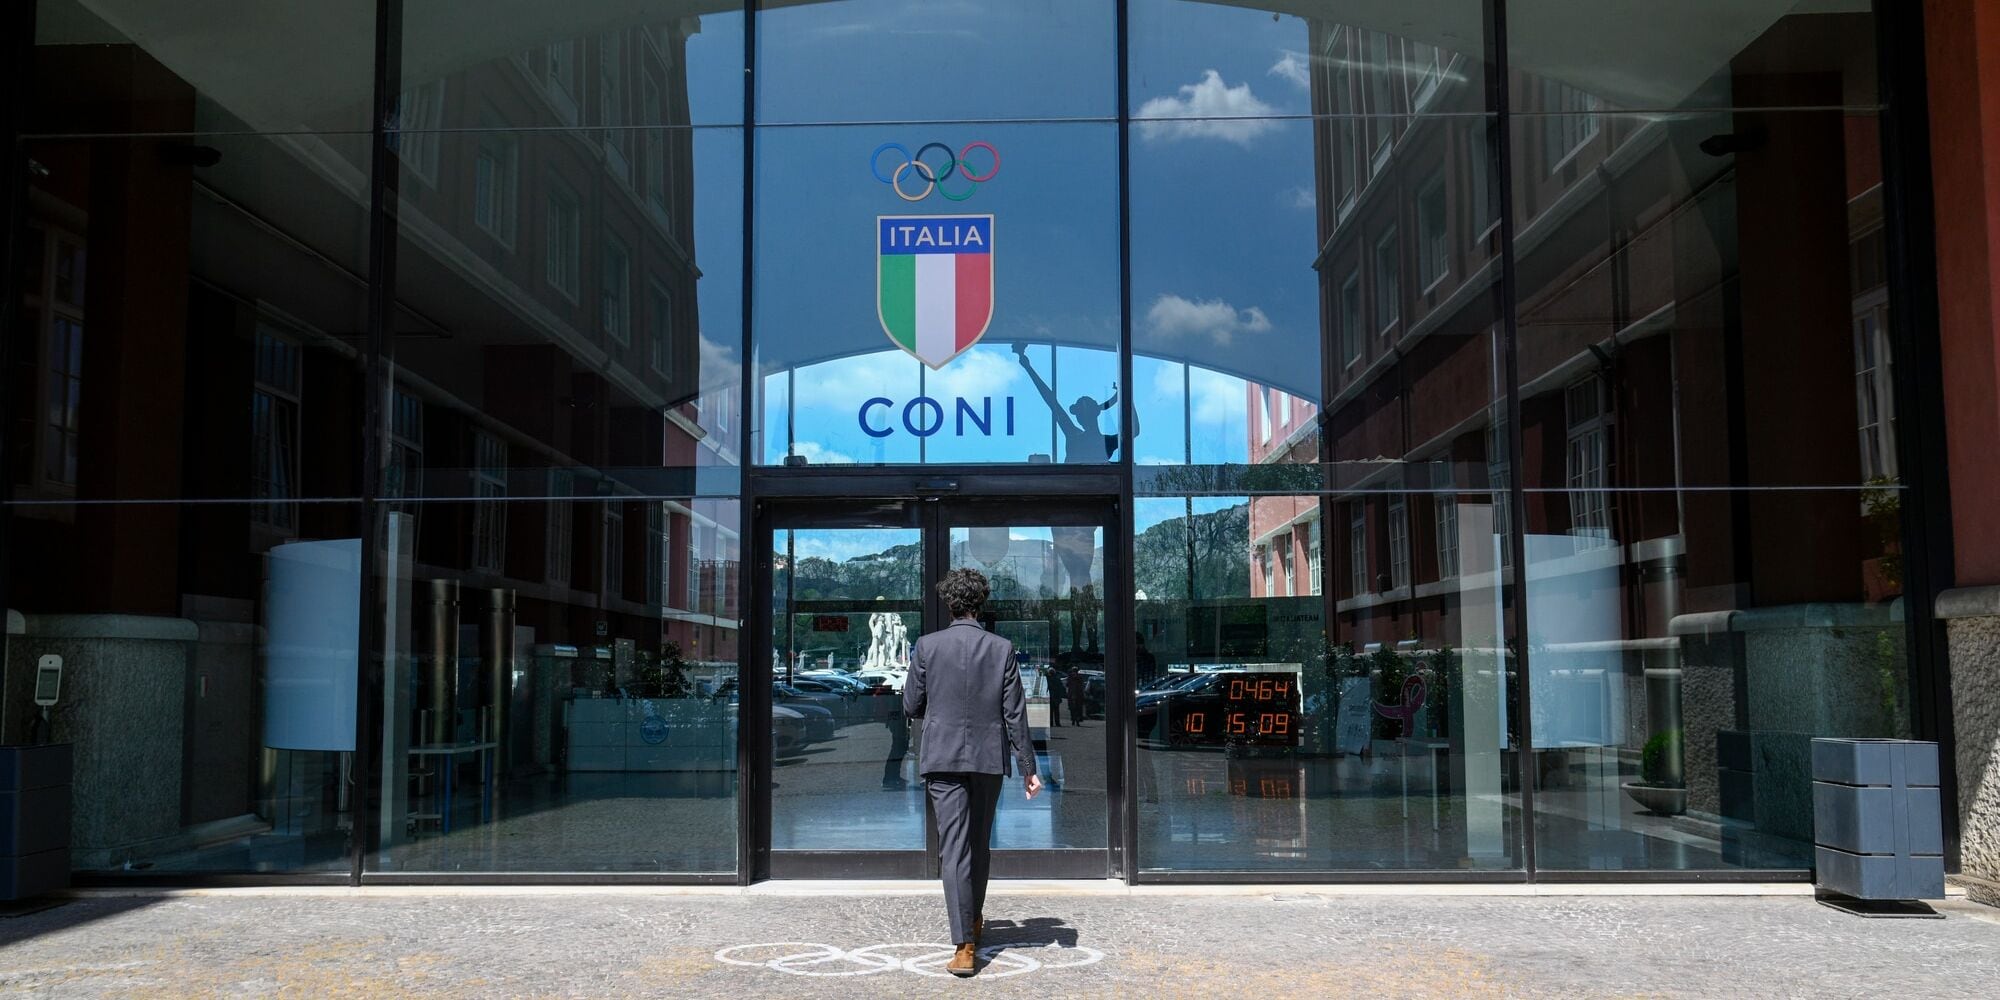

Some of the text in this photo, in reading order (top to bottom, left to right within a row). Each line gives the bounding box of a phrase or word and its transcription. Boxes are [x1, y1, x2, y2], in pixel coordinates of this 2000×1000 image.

[890, 226, 983, 247] ITALIA
[858, 396, 1014, 438] CONI
[1229, 679, 1289, 700] 0464
[1185, 712, 1289, 734] 10 15 09
